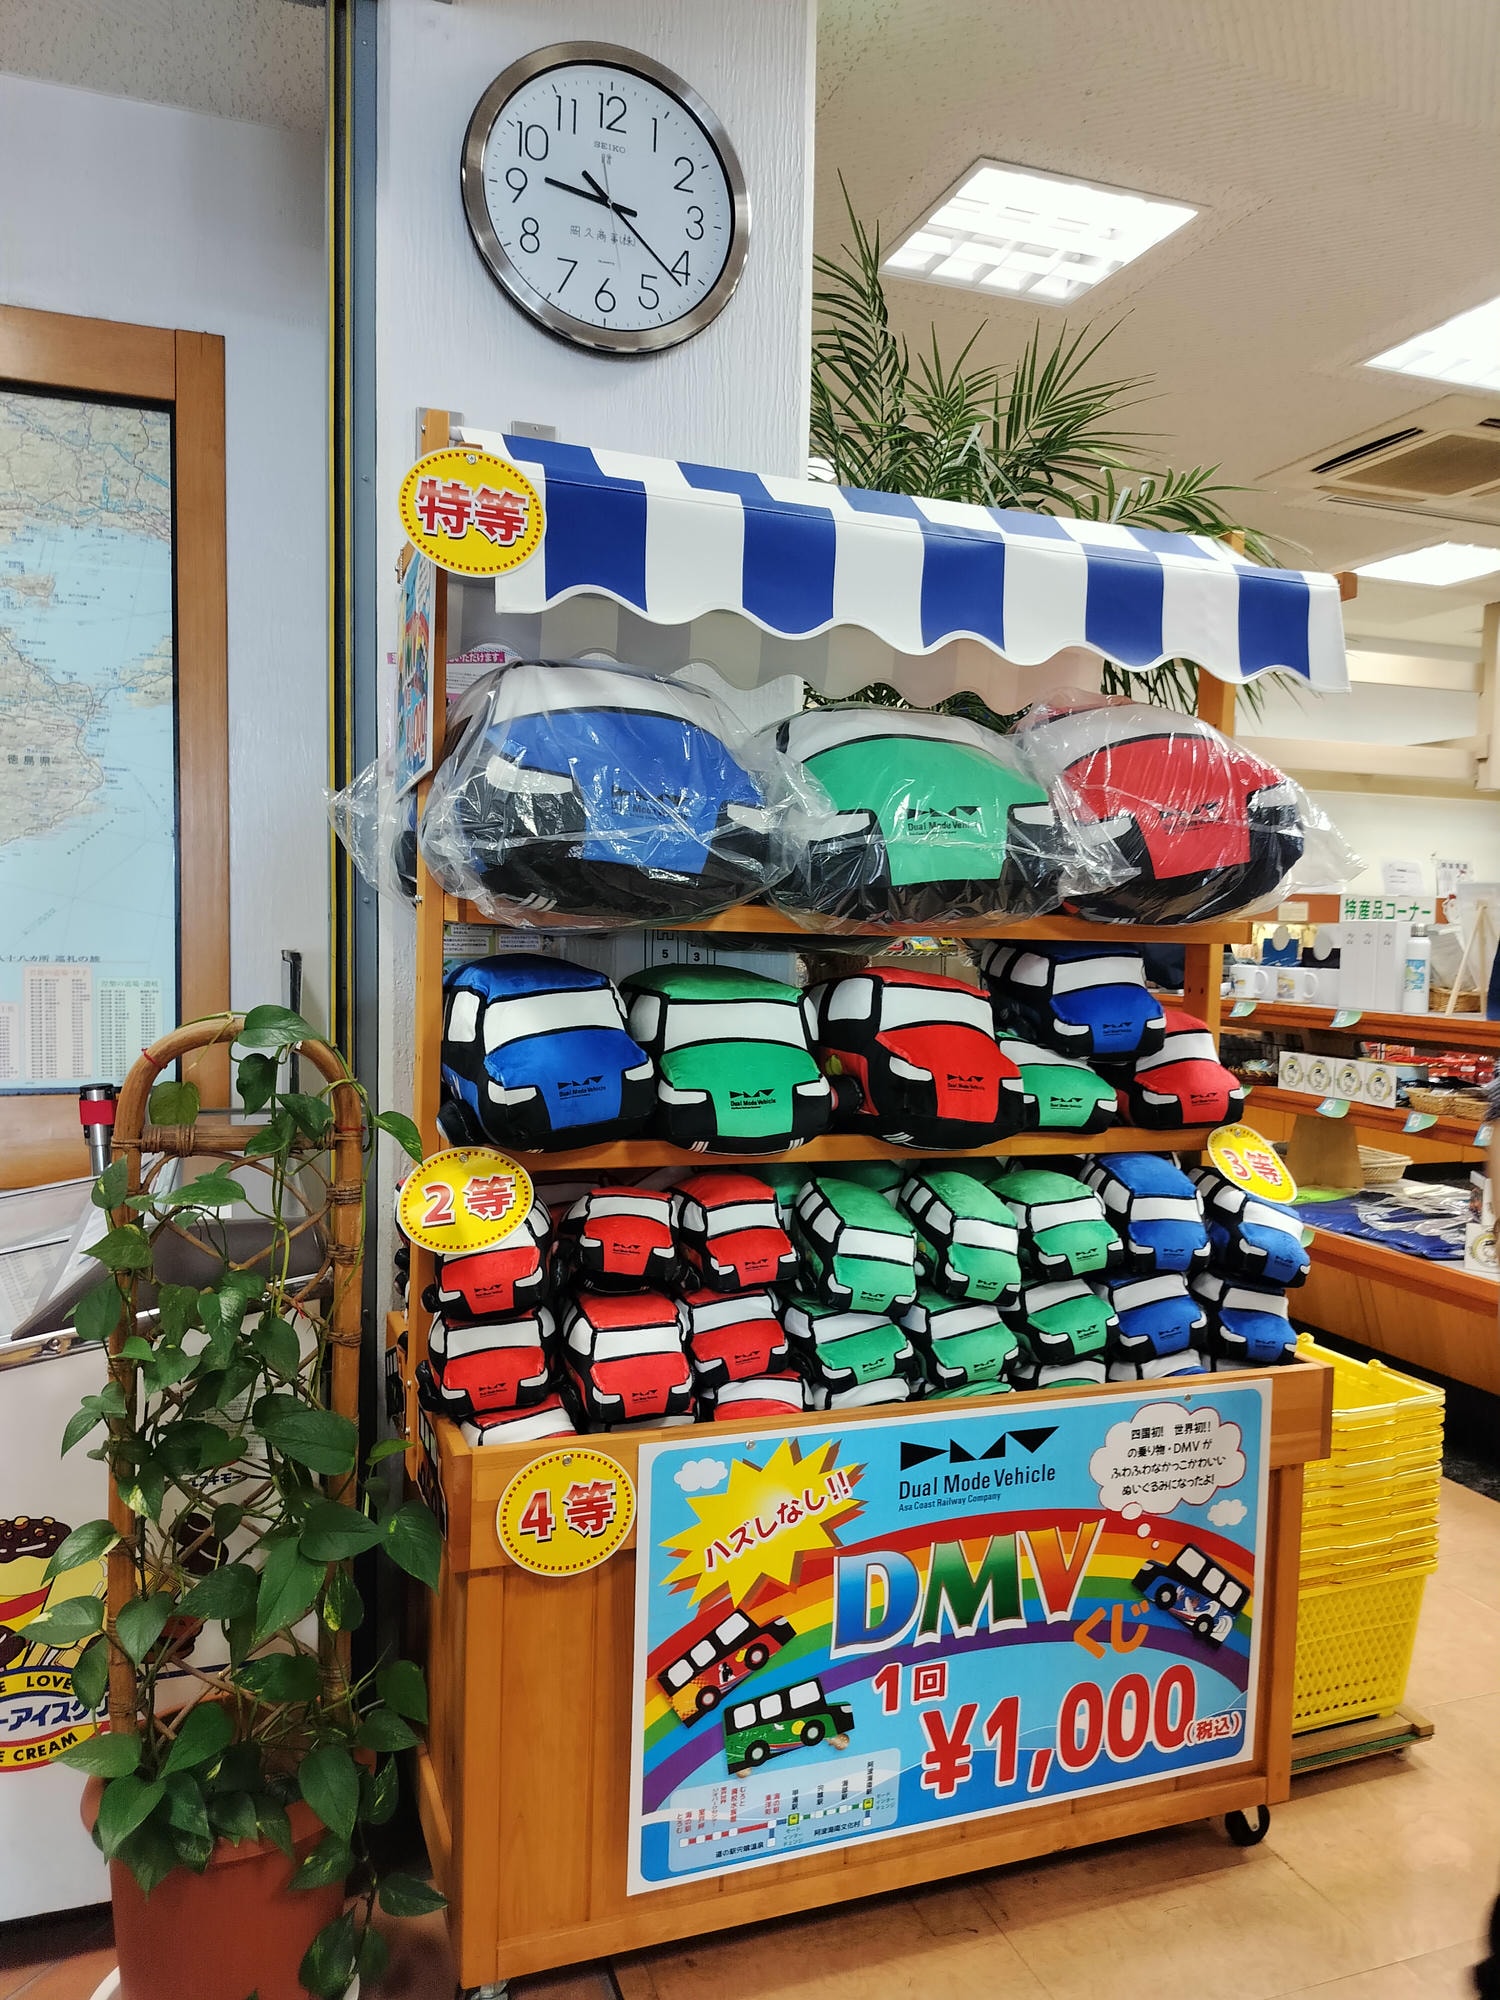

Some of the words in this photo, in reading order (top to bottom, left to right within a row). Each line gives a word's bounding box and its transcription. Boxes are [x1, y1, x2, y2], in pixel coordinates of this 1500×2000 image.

[555, 95, 577, 135] 11
[598, 92, 628, 134] 12
[517, 120, 549, 161] 10
[593, 140, 626, 154] SEIKO
[651, 117, 658, 153] 1
[505, 167, 528, 203] 9
[673, 156, 695, 193] 2
[519, 217, 541, 254] 8
[685, 206, 704, 240] 3
[557, 257, 578, 293] 7
[671, 250, 691, 286] 4
[594, 278, 616, 313] 6
[638, 274, 660, 310] 5
[418, 477, 530, 546] 特等
[1344, 897, 1432, 922] 特産品コーナー
[1220, 1148, 1282, 1186] 3等
[422, 1174, 516, 1228] 2等
[1131, 1426, 1164, 1441] 四国初!
[1174, 1421, 1211, 1436] 世界初!!
[899, 1477, 937, 1499] Dual
[943, 1472, 990, 1493] Mode
[994, 1464, 1056, 1487] Vehicle
[1121, 1474, 1216, 1496] ぬいぐるみになったよ!
[520, 1478, 617, 1542] 4等
[898, 1503, 912, 1512] Asa
[914, 1500, 935, 1510] Coast
[937, 1496, 966, 1507] Railway
[968, 1493, 1001, 1503] Company
[830, 1518, 1106, 1659] DMV
[1073, 1600, 1150, 1659] くじ
[26, 1675, 72, 1690] LOVE
[873, 1662, 949, 1716] 1回
[13, 1732, 78, 1761] CREAM
[920, 1664, 1197, 1799] ¥1,000
[1183, 1711, 1243, 1747] (税込)
